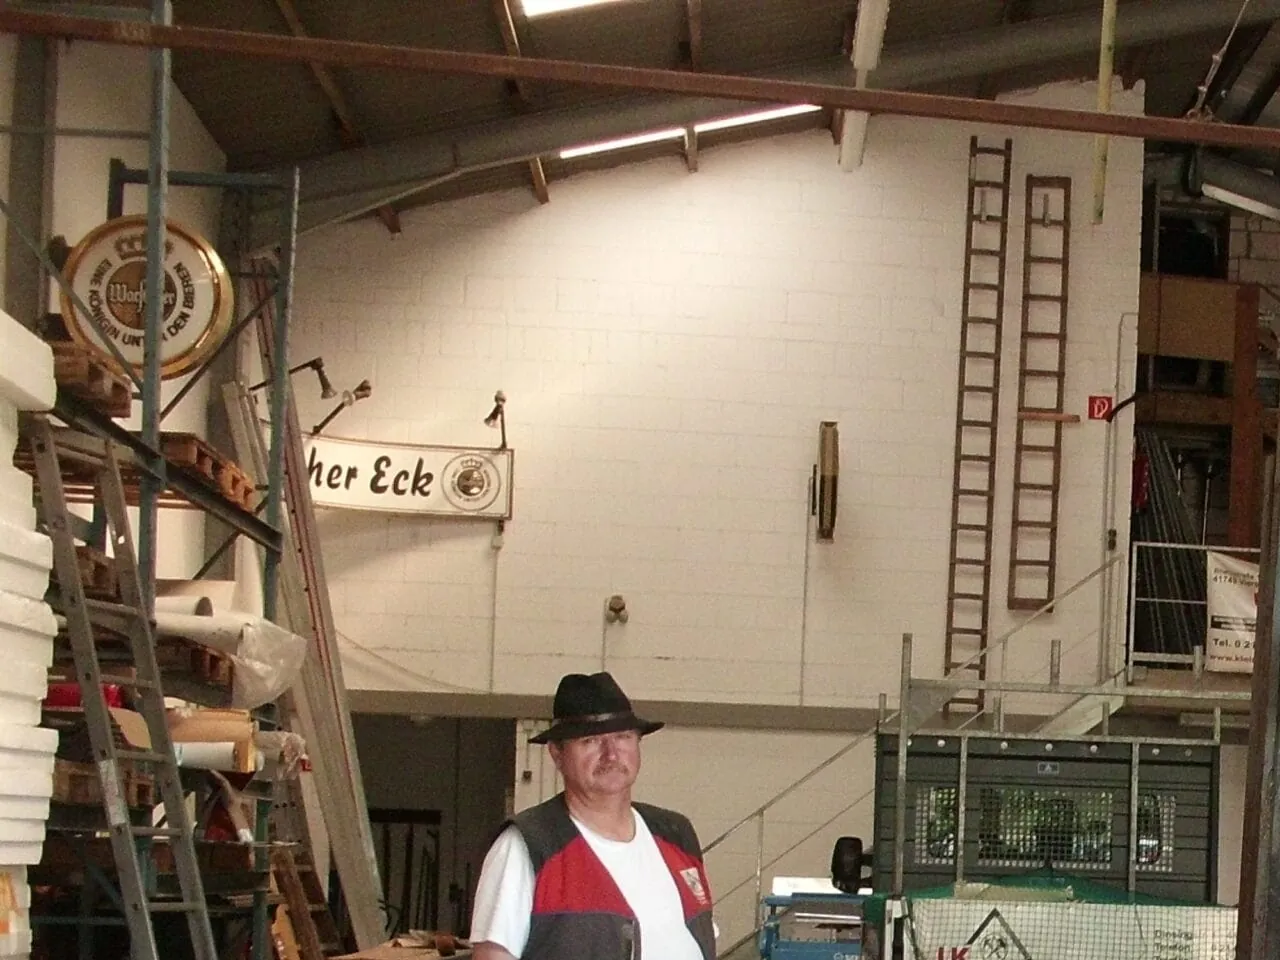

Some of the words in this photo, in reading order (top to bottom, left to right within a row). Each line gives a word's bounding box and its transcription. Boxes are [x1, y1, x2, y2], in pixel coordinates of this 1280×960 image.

[173, 262, 195, 309] BIEREN
[166, 311, 191, 337] DEN
[369, 456, 434, 497] Eck
[1213, 638, 1232, 647] Tel.
